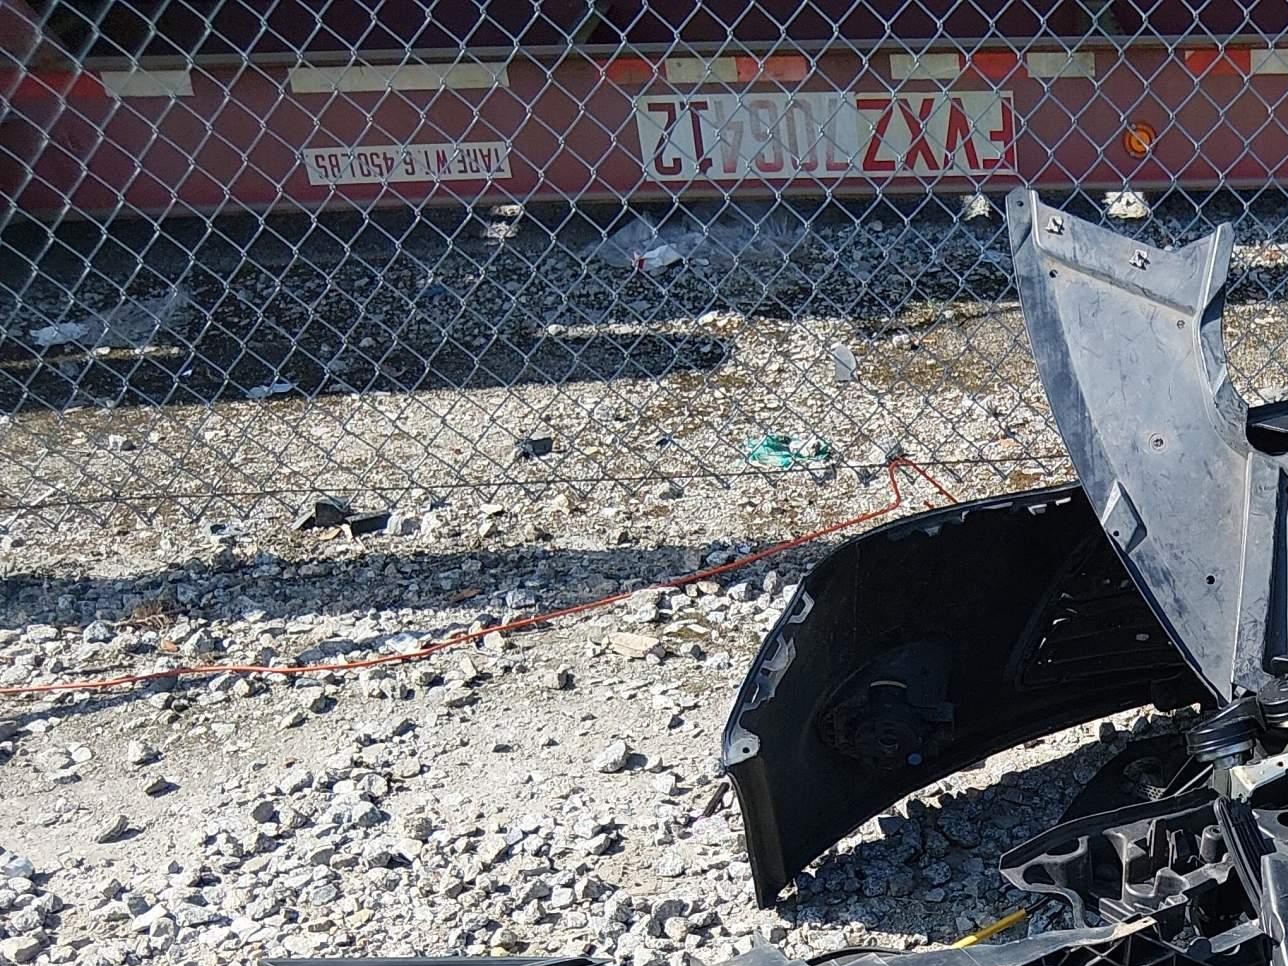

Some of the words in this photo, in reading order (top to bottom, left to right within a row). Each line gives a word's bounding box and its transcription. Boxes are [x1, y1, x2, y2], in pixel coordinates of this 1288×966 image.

[457, 147, 505, 174] TARE
[646, 98, 850, 176] 706412
[856, 96, 1015, 173] FVXZ
